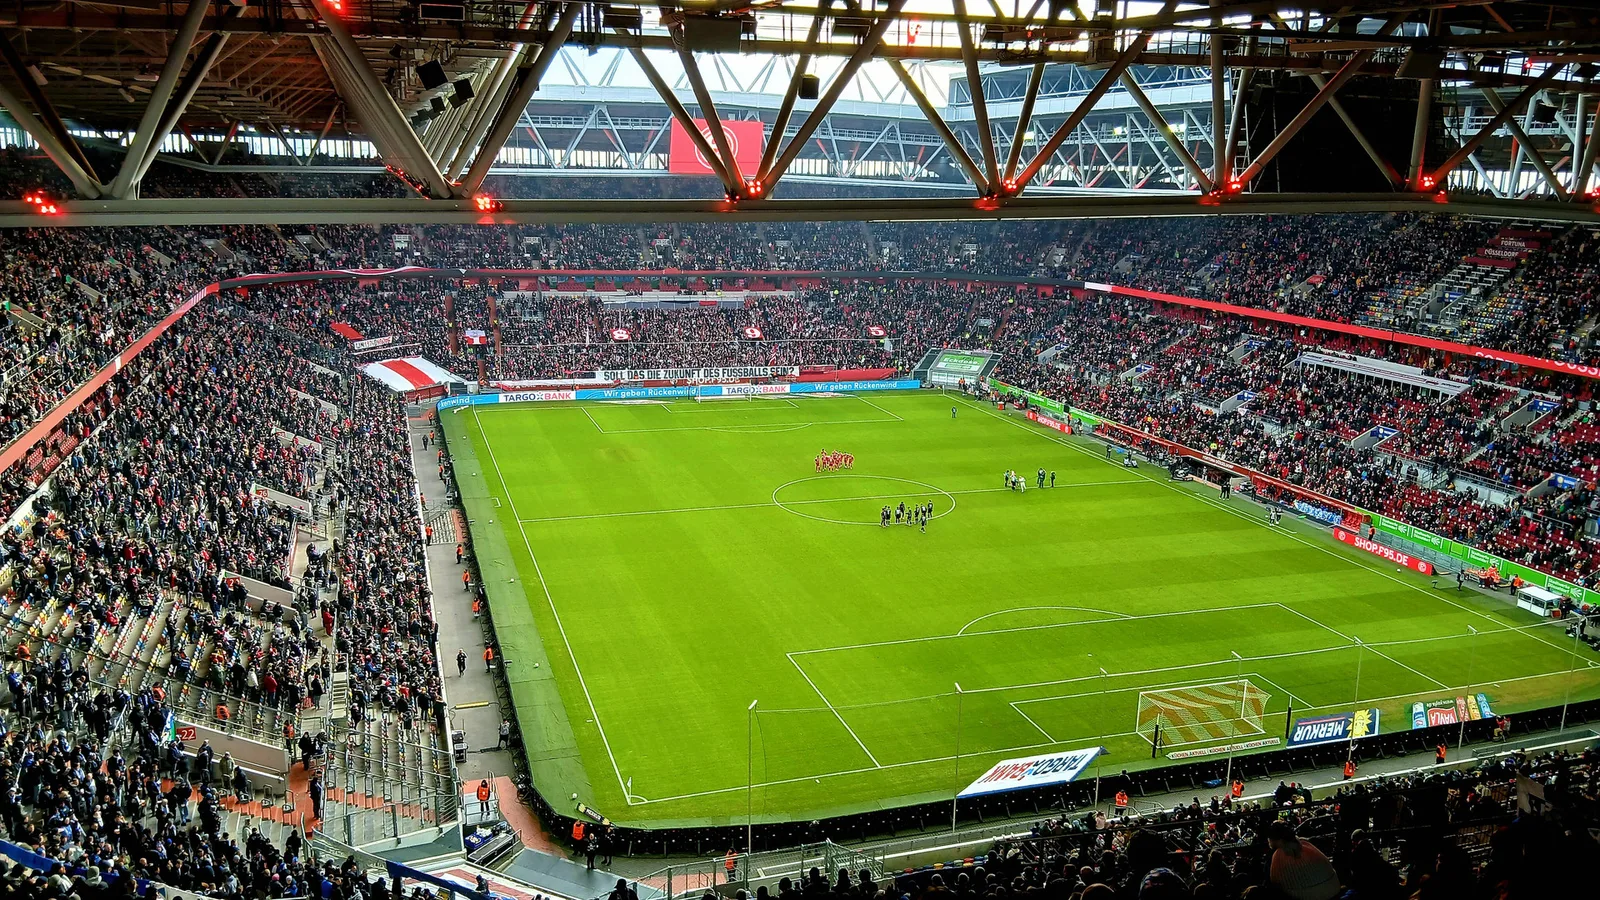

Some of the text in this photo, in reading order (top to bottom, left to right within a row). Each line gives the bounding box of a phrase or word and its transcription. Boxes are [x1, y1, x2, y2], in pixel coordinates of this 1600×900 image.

[745, 327, 761, 338] 9
[603, 366, 795, 380] SOLL DAS DIE ZUKUNFT DES FUSSBALLS SEIN?
[620, 387, 646, 398] geben
[815, 383, 828, 391] Wir
[829, 382, 853, 392] geben
[1354, 537, 1409, 566] SHOP.F95.DE
[1430, 711, 1456, 726] YAYLA
[181, 729, 196, 740] 22
[1293, 720, 1345, 742] MERKUR
